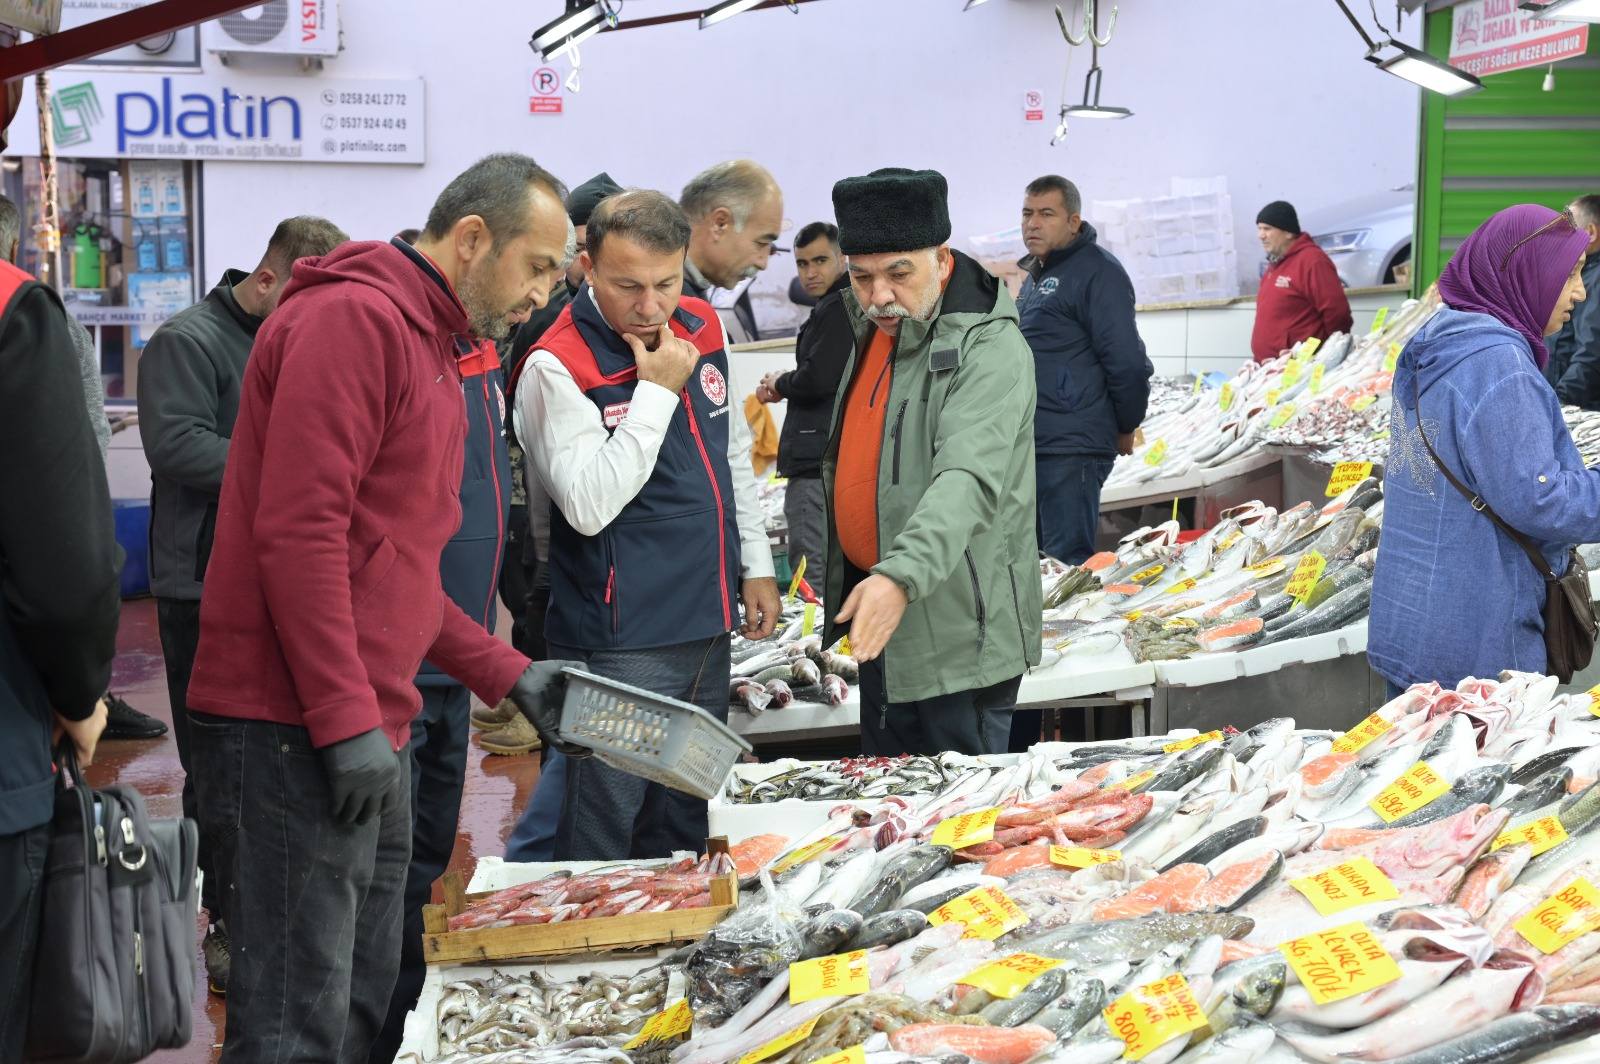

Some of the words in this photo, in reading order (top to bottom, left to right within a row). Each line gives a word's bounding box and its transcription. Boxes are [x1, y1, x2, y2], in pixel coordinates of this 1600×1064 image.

[1491, 47, 1518, 68] SOĞUK
[1519, 44, 1541, 62] MEZE
[1541, 34, 1580, 57] BULUNUR
[341, 92, 363, 104] 0258
[364, 93, 382, 105] 241
[383, 93, 394, 105] 27
[396, 93, 407, 106] 72
[116, 77, 302, 153] platin
[77, 312, 105, 322] BAHÇE
[110, 313, 146, 321] MARKET
[1319, 931, 1366, 982] LEVREK
[1351, 932, 1386, 960] OLTA
